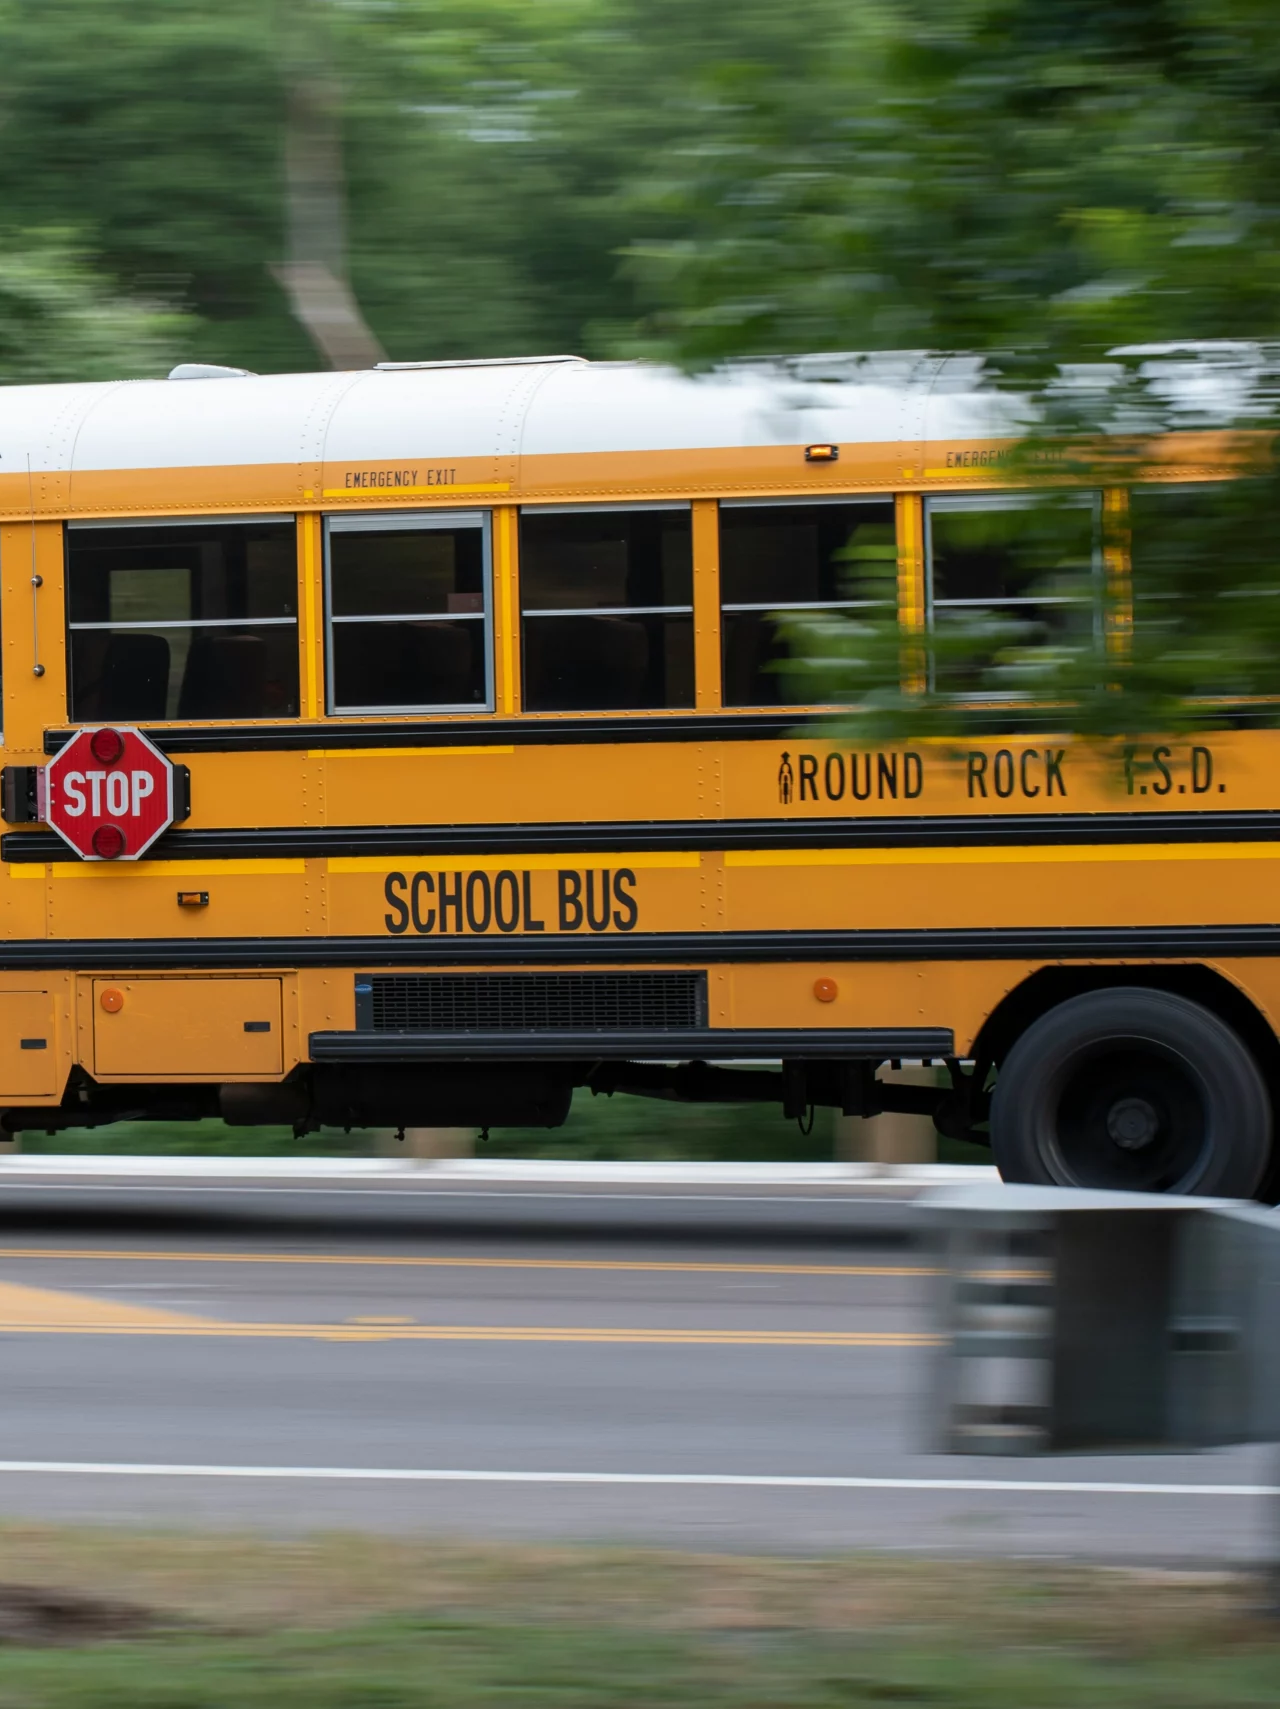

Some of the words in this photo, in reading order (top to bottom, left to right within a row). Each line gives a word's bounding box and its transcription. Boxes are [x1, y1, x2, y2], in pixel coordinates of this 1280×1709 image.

[345, 470, 418, 488] EMERGENCY
[427, 469, 456, 486] EXIT
[63, 770, 154, 817] STOP
[799, 752, 923, 801] ROUND
[967, 749, 1067, 799] ROCK
[384, 870, 545, 934] SCHOOL
[558, 868, 638, 931] BUS
